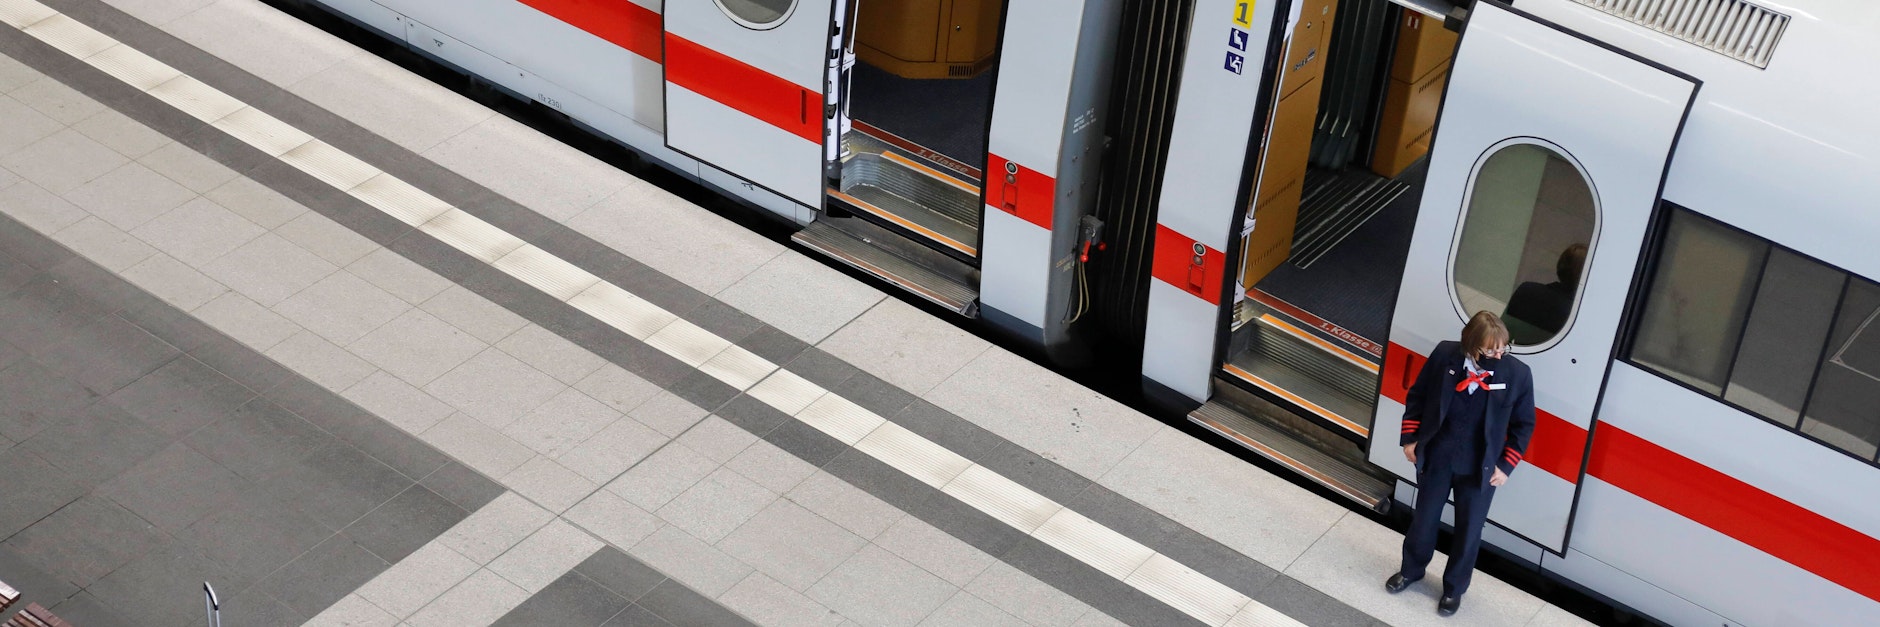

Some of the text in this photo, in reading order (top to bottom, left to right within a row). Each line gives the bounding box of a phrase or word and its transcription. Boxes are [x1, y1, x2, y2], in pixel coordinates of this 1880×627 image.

[1236, 2, 1248, 25] 1
[929, 153, 968, 172] Klasse
[1320, 322, 1370, 348] 1. Klasse
